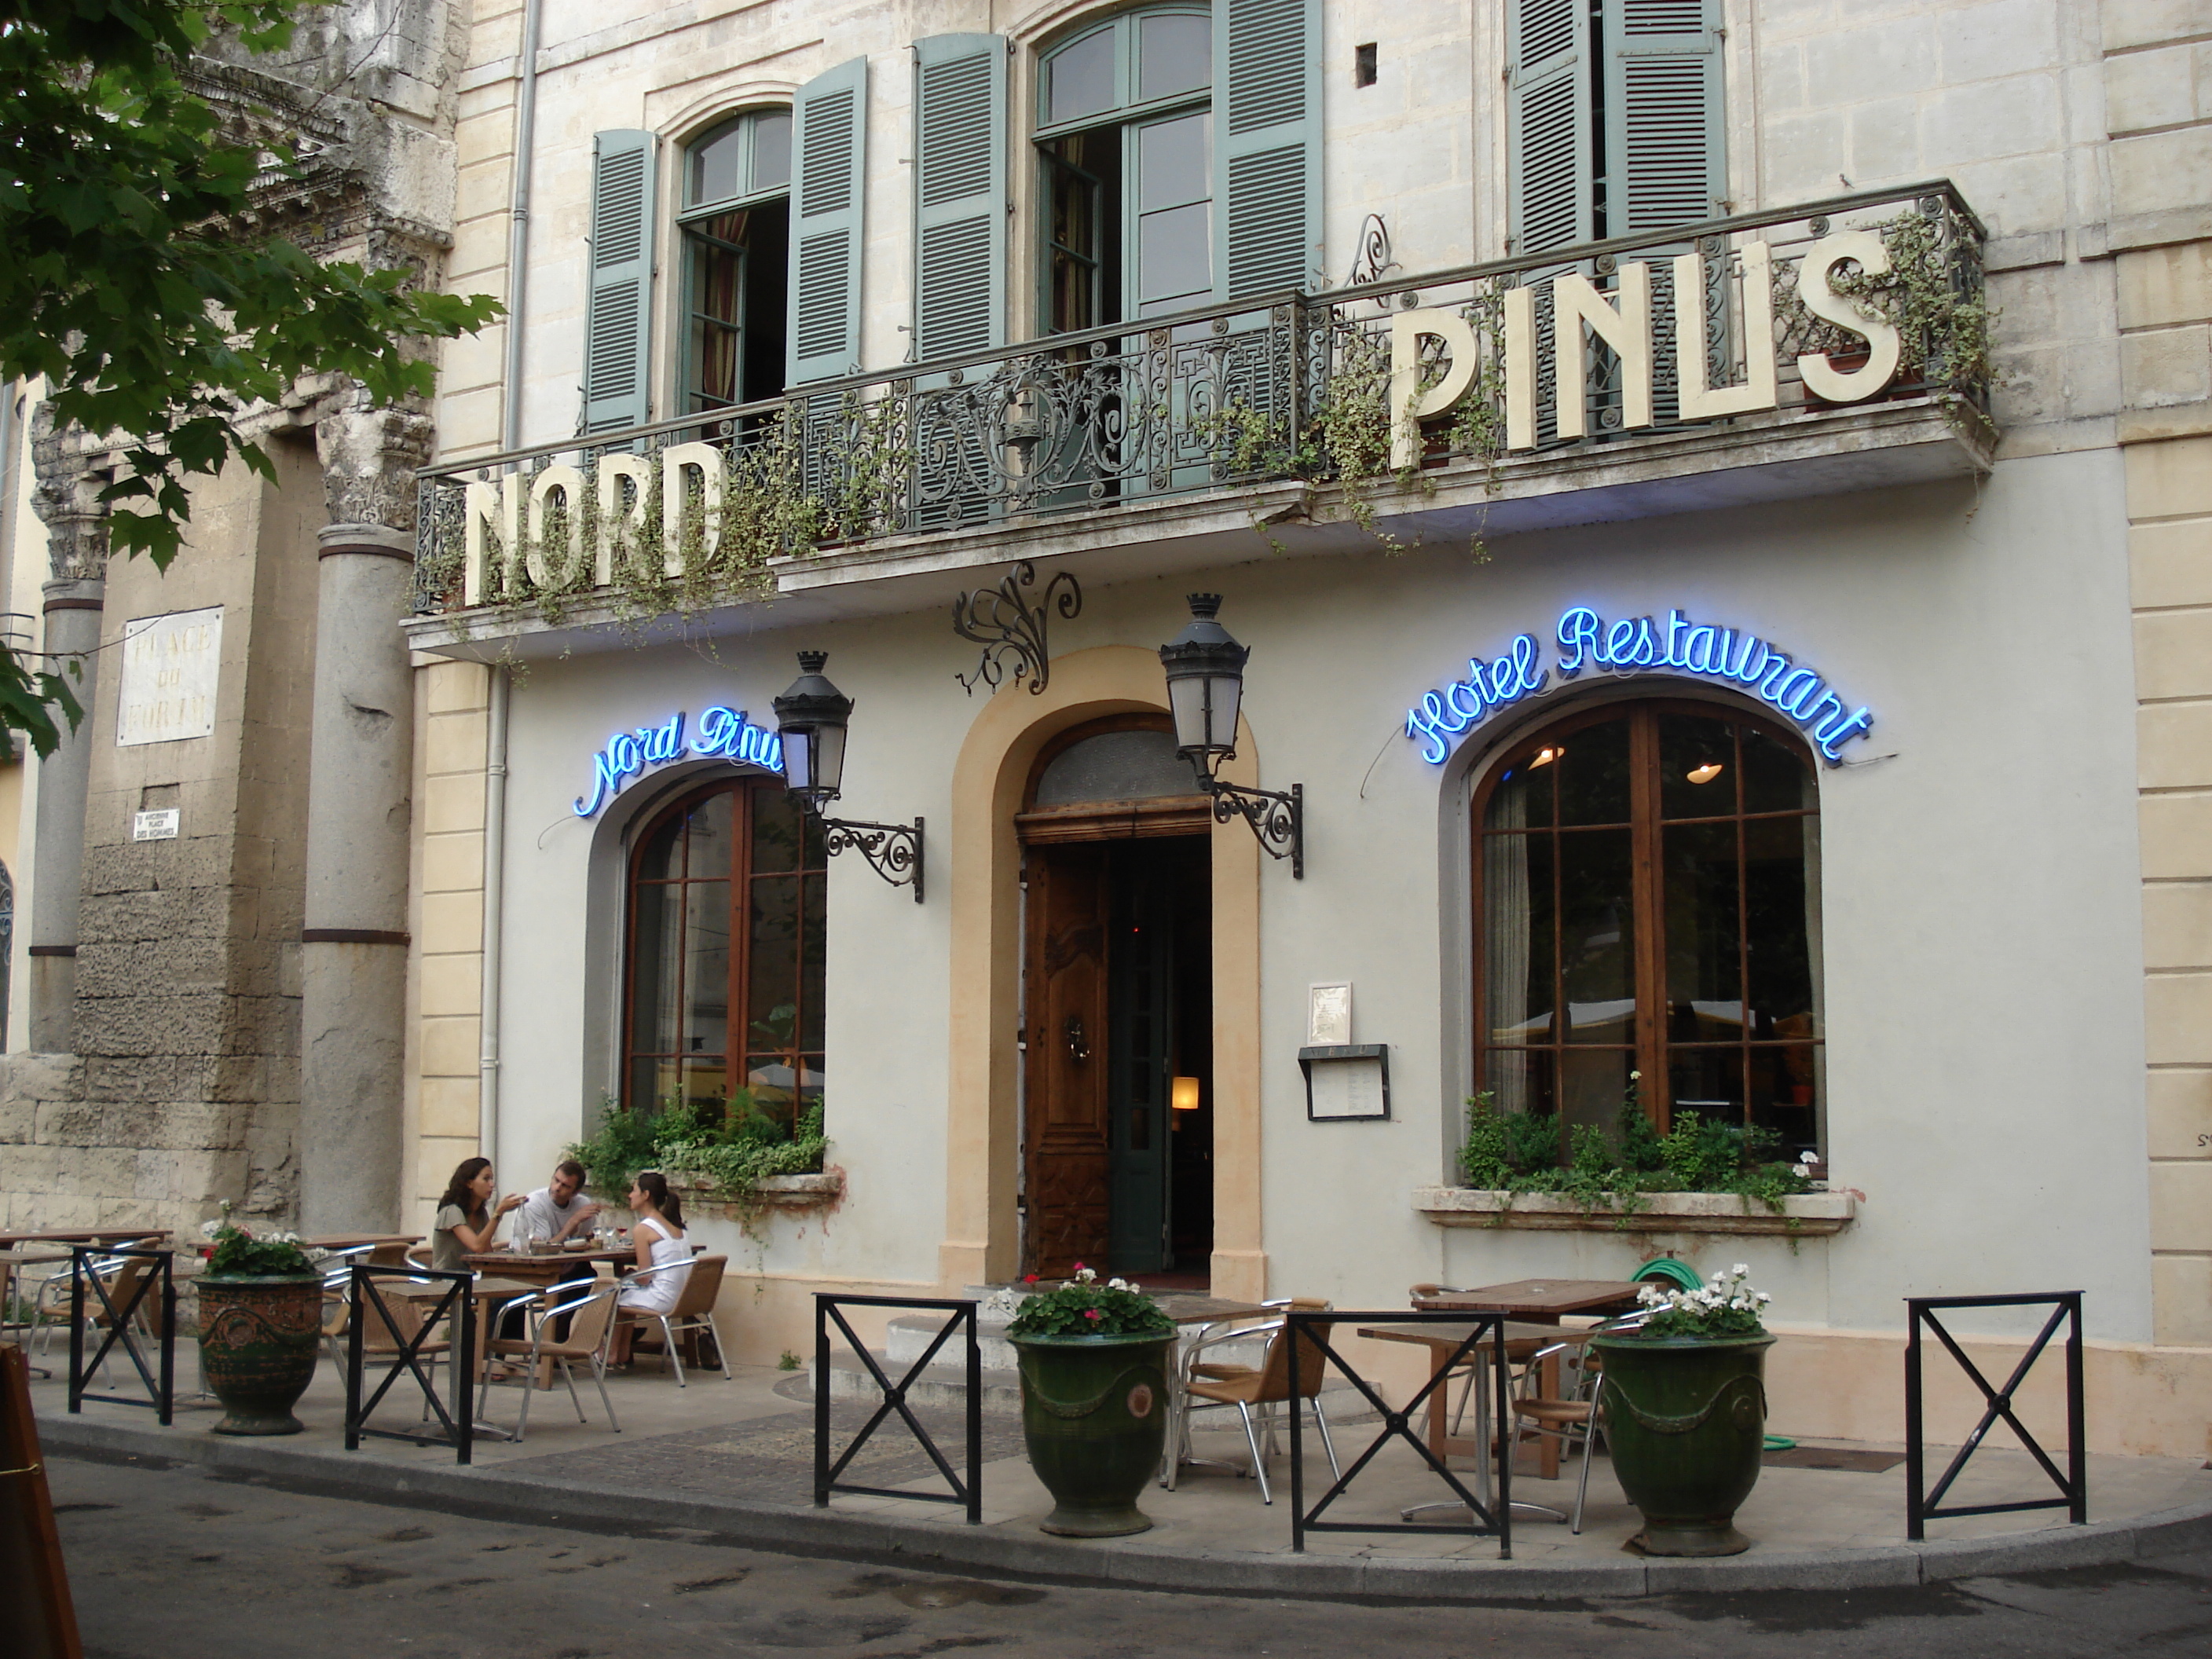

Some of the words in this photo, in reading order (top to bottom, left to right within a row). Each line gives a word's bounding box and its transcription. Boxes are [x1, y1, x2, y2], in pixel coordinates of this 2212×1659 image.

[464, 441, 727, 607] NORD
[1390, 230, 1901, 470] PINUS
[573, 711, 687, 818] Nord
[690, 706, 785, 772] Pinu
[1405, 633, 1547, 764] Hotel
[1555, 606, 1873, 765] Restaurant
